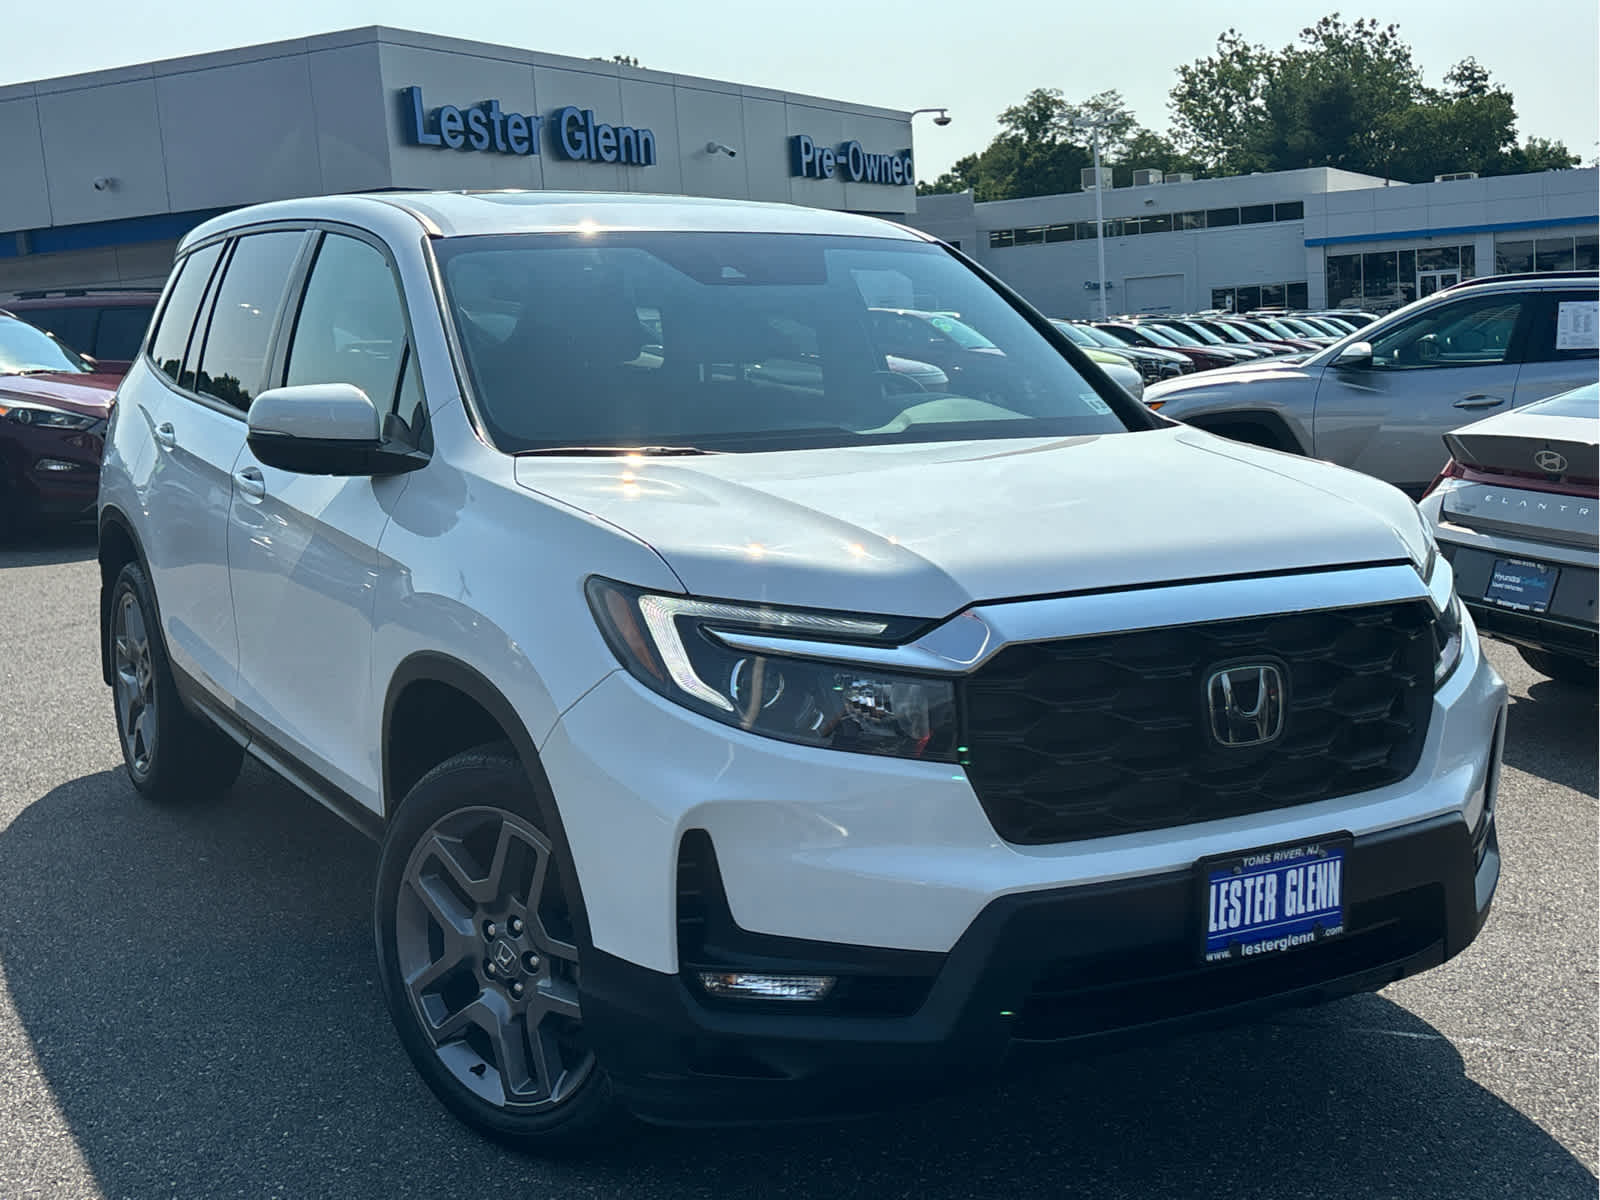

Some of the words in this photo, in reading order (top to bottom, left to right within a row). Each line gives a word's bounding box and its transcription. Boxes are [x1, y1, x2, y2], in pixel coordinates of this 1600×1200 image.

[401, 86, 543, 155] Lester
[553, 106, 656, 166] Glenn
[1243, 854, 1272, 867] TOMS
[1306, 845, 1319, 855] NJ
[1209, 873, 1278, 932] LESTER
[1284, 860, 1341, 917] GLENN
[1241, 932, 1315, 956] lesterglenn
